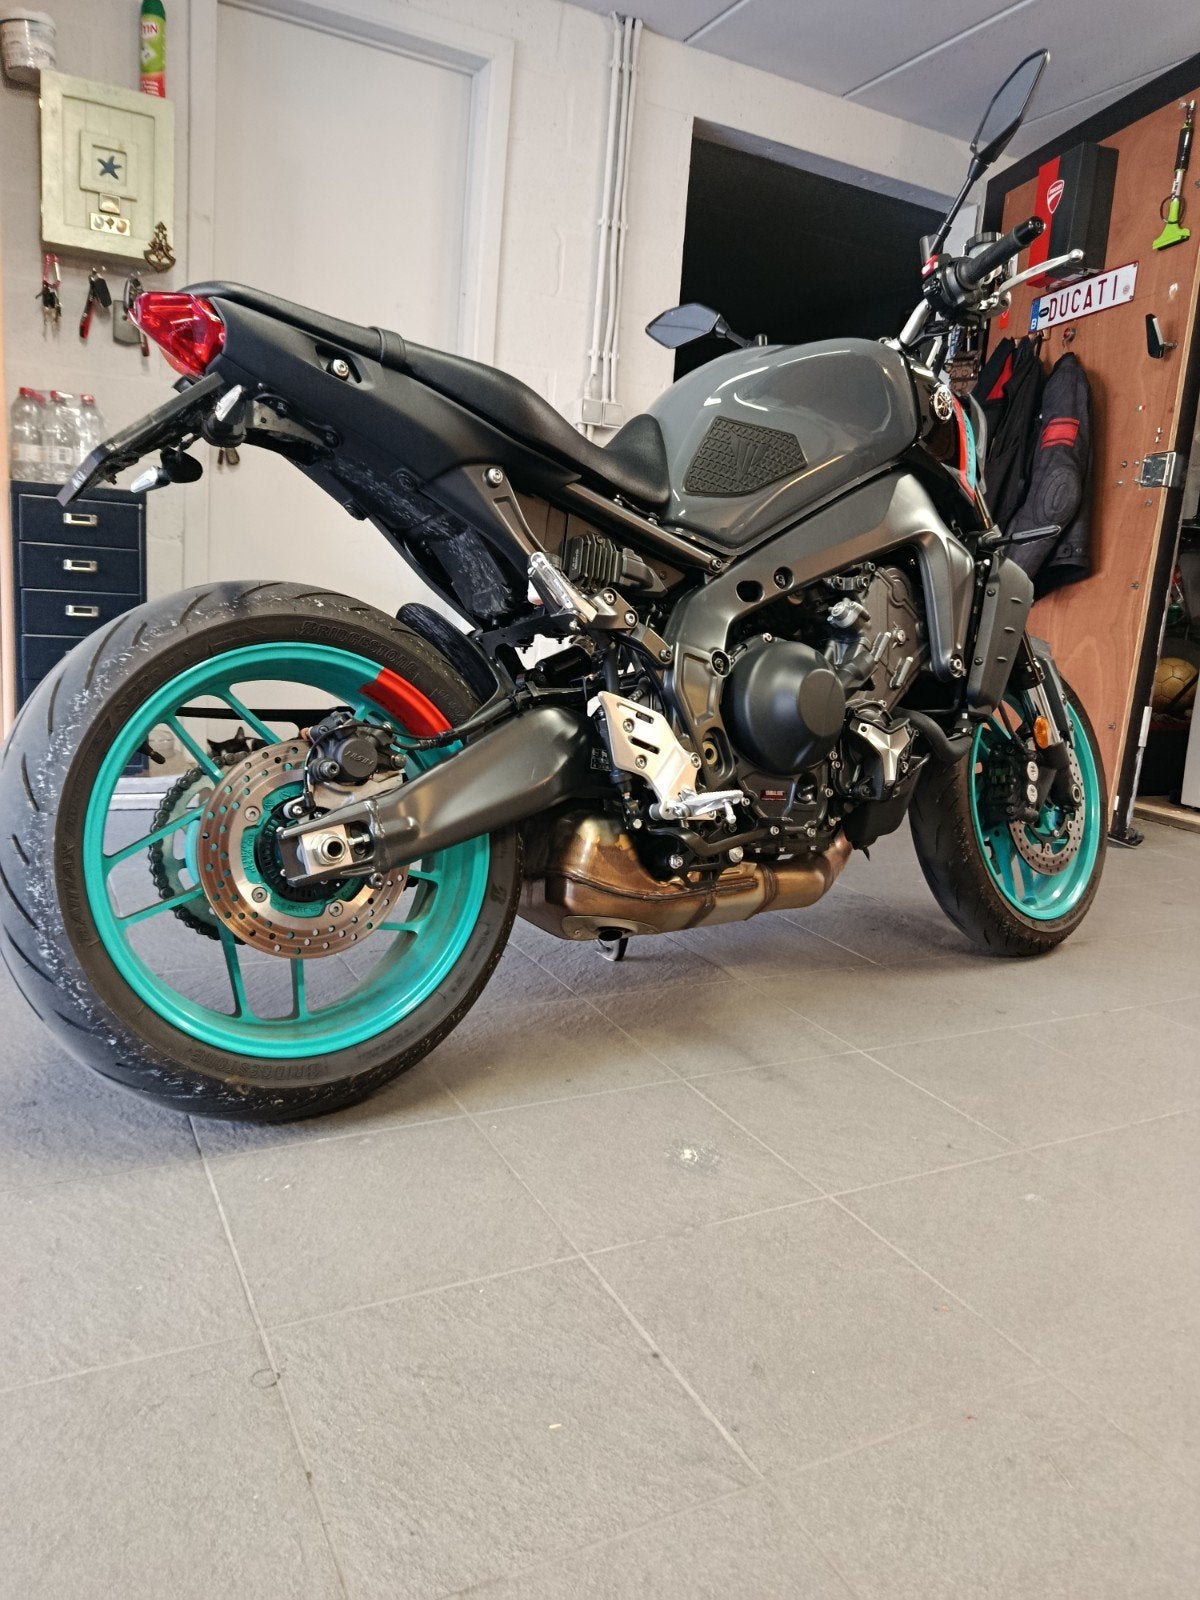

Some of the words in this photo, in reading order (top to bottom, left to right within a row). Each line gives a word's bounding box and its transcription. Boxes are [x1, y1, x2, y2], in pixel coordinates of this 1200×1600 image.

[1048, 275, 1118, 322] DUCATI
[1031, 318, 1038, 330] B
[300, 621, 417, 671] BRIDGESTONE
